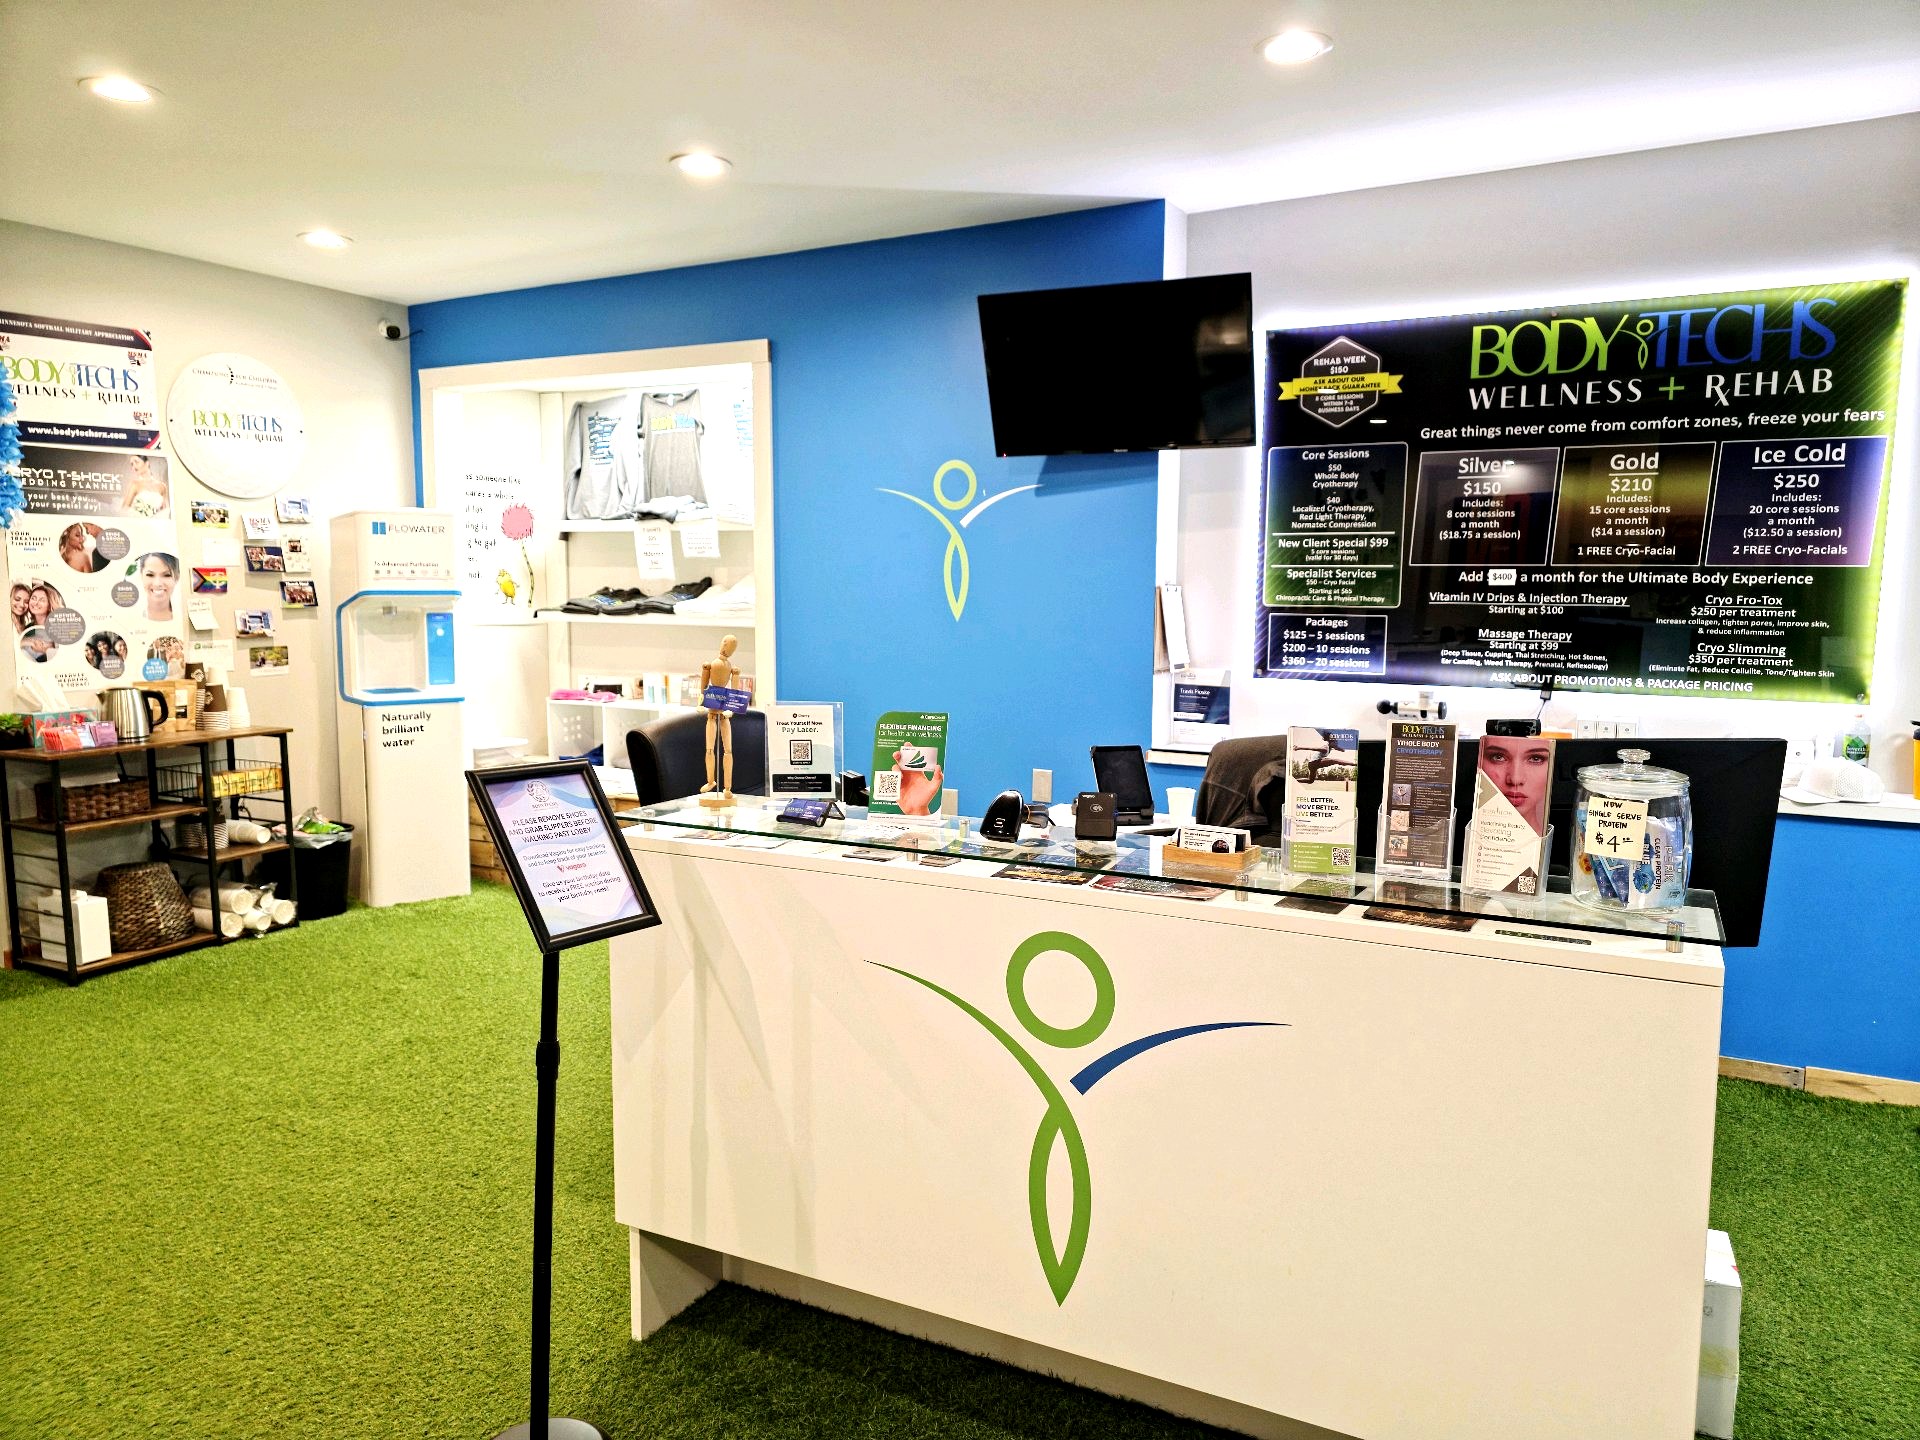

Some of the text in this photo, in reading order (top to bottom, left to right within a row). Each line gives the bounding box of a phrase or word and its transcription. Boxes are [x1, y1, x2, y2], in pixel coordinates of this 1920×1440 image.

[1470, 298, 1838, 380] BODY TECHS
[1313, 355, 1366, 366] REHAB WEEK
[1330, 366, 1348, 374] $150
[1342, 382, 1381, 390] GUARANTEE
[1468, 378, 1643, 410] WELLNESS
[1420, 408, 1886, 440] Great things never come from comfort zones, freeze your fears
[1302, 450, 1370, 460] Core Sessions
[1754, 443, 1846, 463] Ice Cold
[1458, 457, 1512, 474] Silver
[1610, 452, 1659, 471] Gold
[1328, 464, 1342, 472] $50
[58, 470, 121, 483] T-SHOCK
[1315, 472, 1359, 480] Whole Body
[1773, 473, 1819, 490] $250
[22, 478, 121, 490] EDDING PLANNER
[1312, 480, 1358, 489] Cryotherapy
[1463, 481, 1501, 497] $150
[1610, 478, 1652, 493] $210
[27, 493, 47, 501] your
[51, 493, 70, 501] best
[1326, 496, 1340, 504] $40
[1771, 493, 1821, 502] Includes:
[30, 501, 49, 509] your
[52, 501, 81, 511] special
[1749, 504, 1840, 514] 20 core sessions
[1778, 516, 1815, 525] month
[388, 523, 446, 533] FLOWATER
[1743, 527, 1842, 538] ($12.50 a session)
[1278, 537, 1389, 549] New Client Special $99
[1577, 545, 1676, 557] 1 FREE Cryo-Facial
[1732, 544, 1848, 557] 2 FREE Cryo-Facials
[1287, 568, 1376, 579] Specialist Services
[1458, 571, 1814, 587] Add $400 a month for the Ultimate Body Experience
[1429, 592, 1628, 606] Vitamin IV Drips & Injection Therapy
[1705, 595, 1783, 607] Cryo Fro-Tox
[1690, 607, 1796, 619] $250 per treatment
[1305, 617, 1349, 628] Packages
[1283, 630, 1307, 640] $125
[1317, 631, 1323, 639] 5
[1325, 632, 1366, 641] sessions
[1697, 642, 1786, 656] Cryo Slimming
[1489, 672, 1753, 692] ASK ABOUT PROMOTIONS & PACKAGE PRICING
[381, 710, 431, 722] Naturally
[382, 724, 425, 735] brilliant
[781, 726, 796, 735] Pay
[880, 723, 942, 732] FLEXIBLE FINANCING
[382, 739, 415, 747] water
[1396, 747, 1443, 755] CRYOTHERAPY
[512, 810, 587, 826] PLEASE REMOVE SHOES
[1588, 809, 1642, 820] SINGLE SERVE
[508, 817, 599, 836] AND GRAB SLIPPERS BEFORE
[1598, 819, 1628, 829] PROTEIN
[521, 832, 554, 843] WALKING
[554, 830, 570, 838] PAST
[1654, 837, 1662, 890] CLEAR PROTEIN
